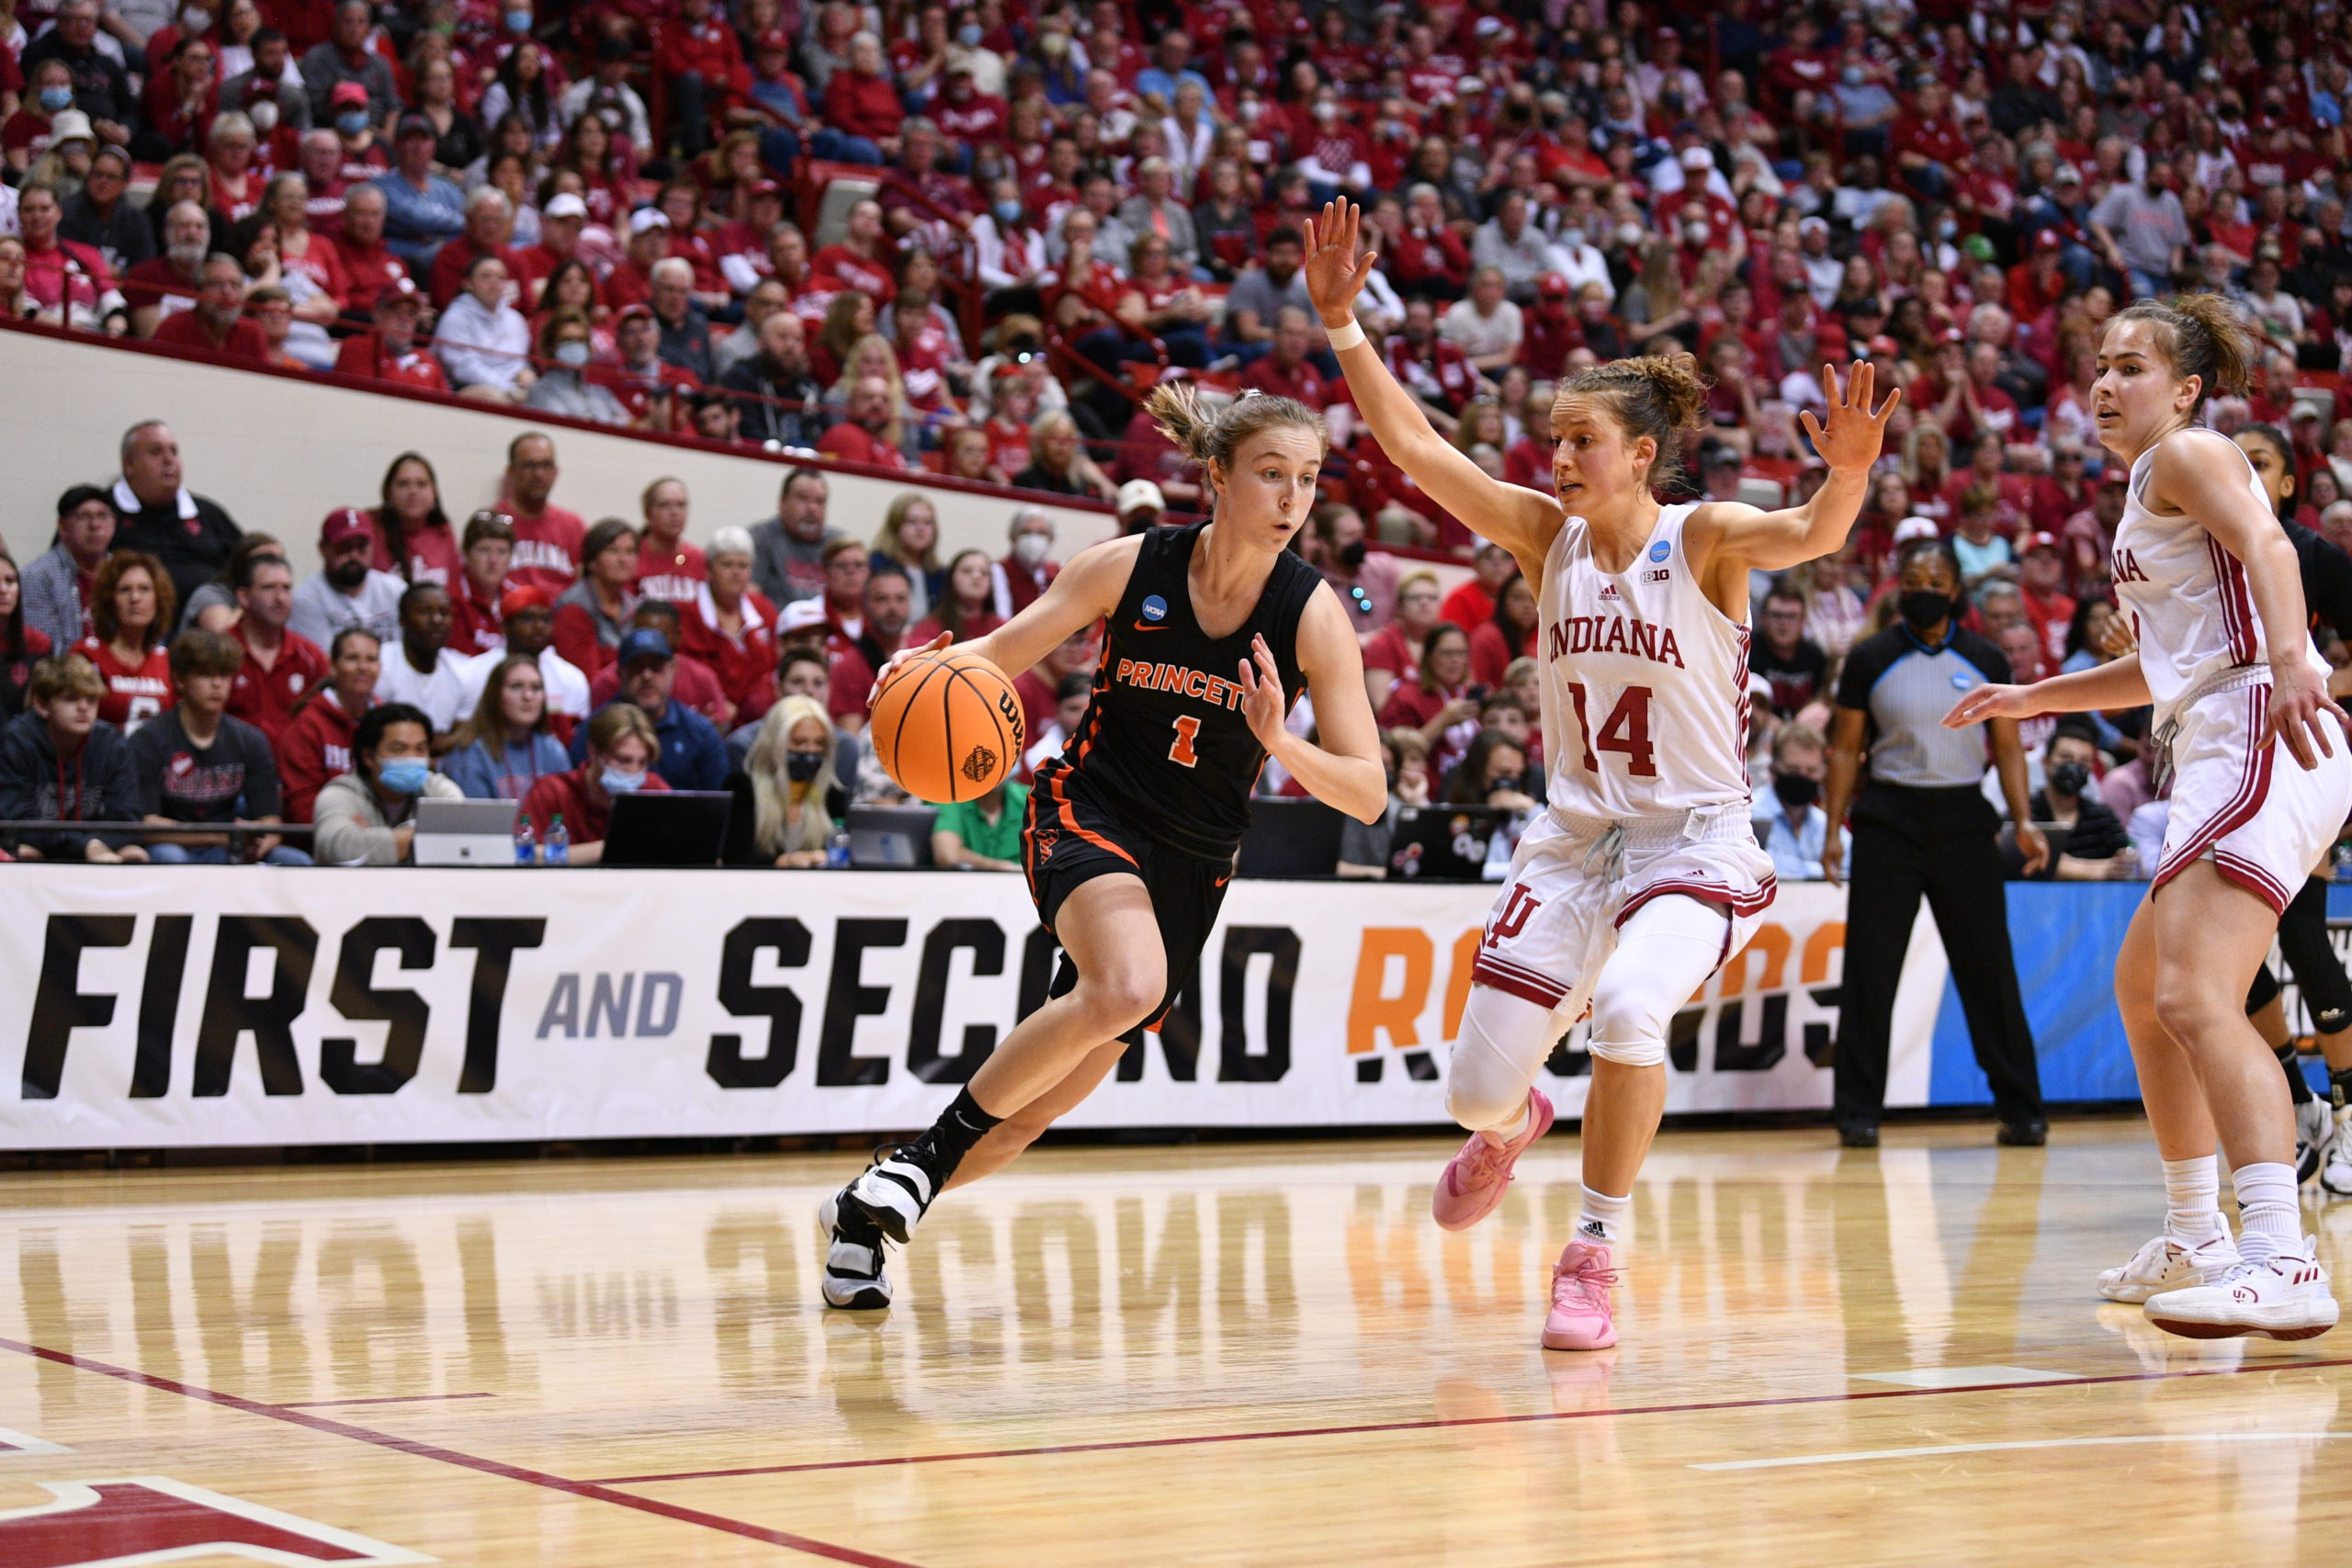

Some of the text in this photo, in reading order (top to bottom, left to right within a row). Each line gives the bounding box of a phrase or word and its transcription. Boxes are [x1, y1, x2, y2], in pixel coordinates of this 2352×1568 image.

[1145, 604, 1165, 617] NCAA
[1549, 615, 1685, 670] INDIANA
[1116, 659, 1248, 716] PRINCET
[1168, 715, 1202, 769] 1
[1567, 682, 1657, 777] 14
[21, 914, 548, 1100] FIRST
[535, 972, 684, 1039] AND
